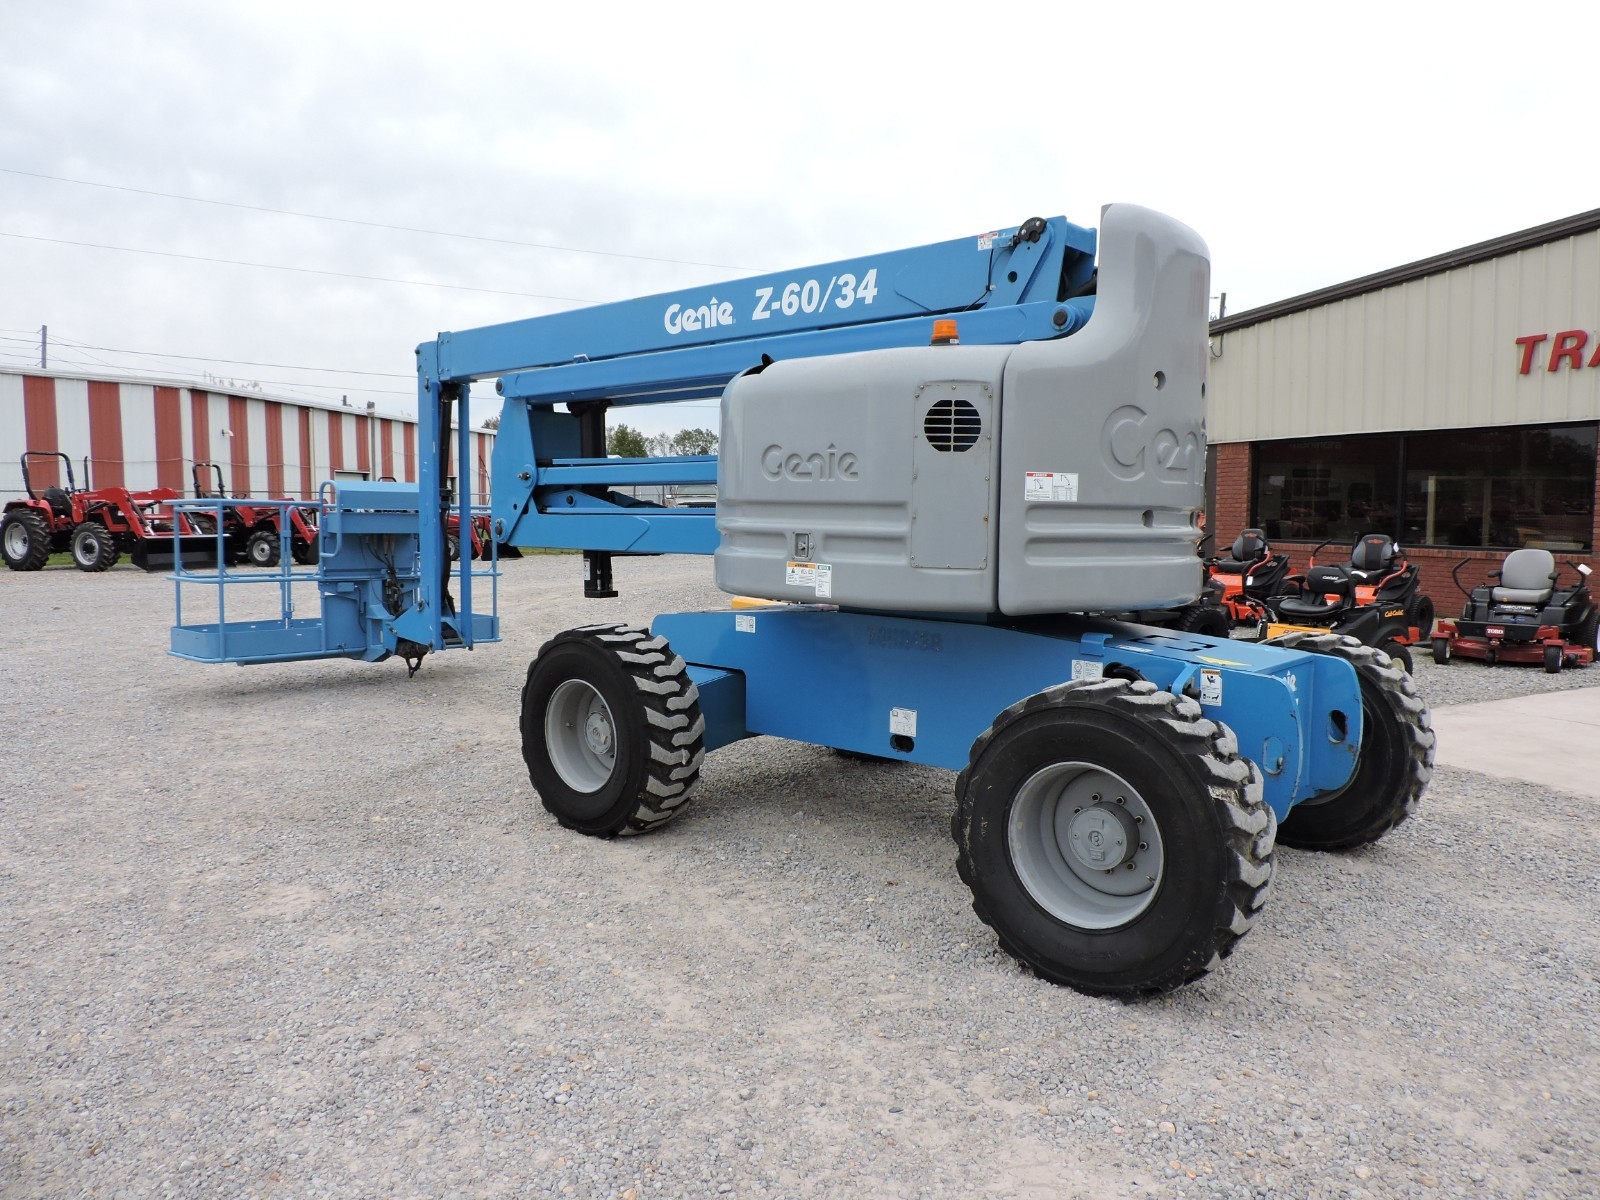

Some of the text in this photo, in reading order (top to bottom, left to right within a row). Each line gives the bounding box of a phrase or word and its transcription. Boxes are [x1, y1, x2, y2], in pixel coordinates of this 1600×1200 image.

[664, 269, 878, 335] Genie Z-60/34
[761, 443, 859, 482] Genie
